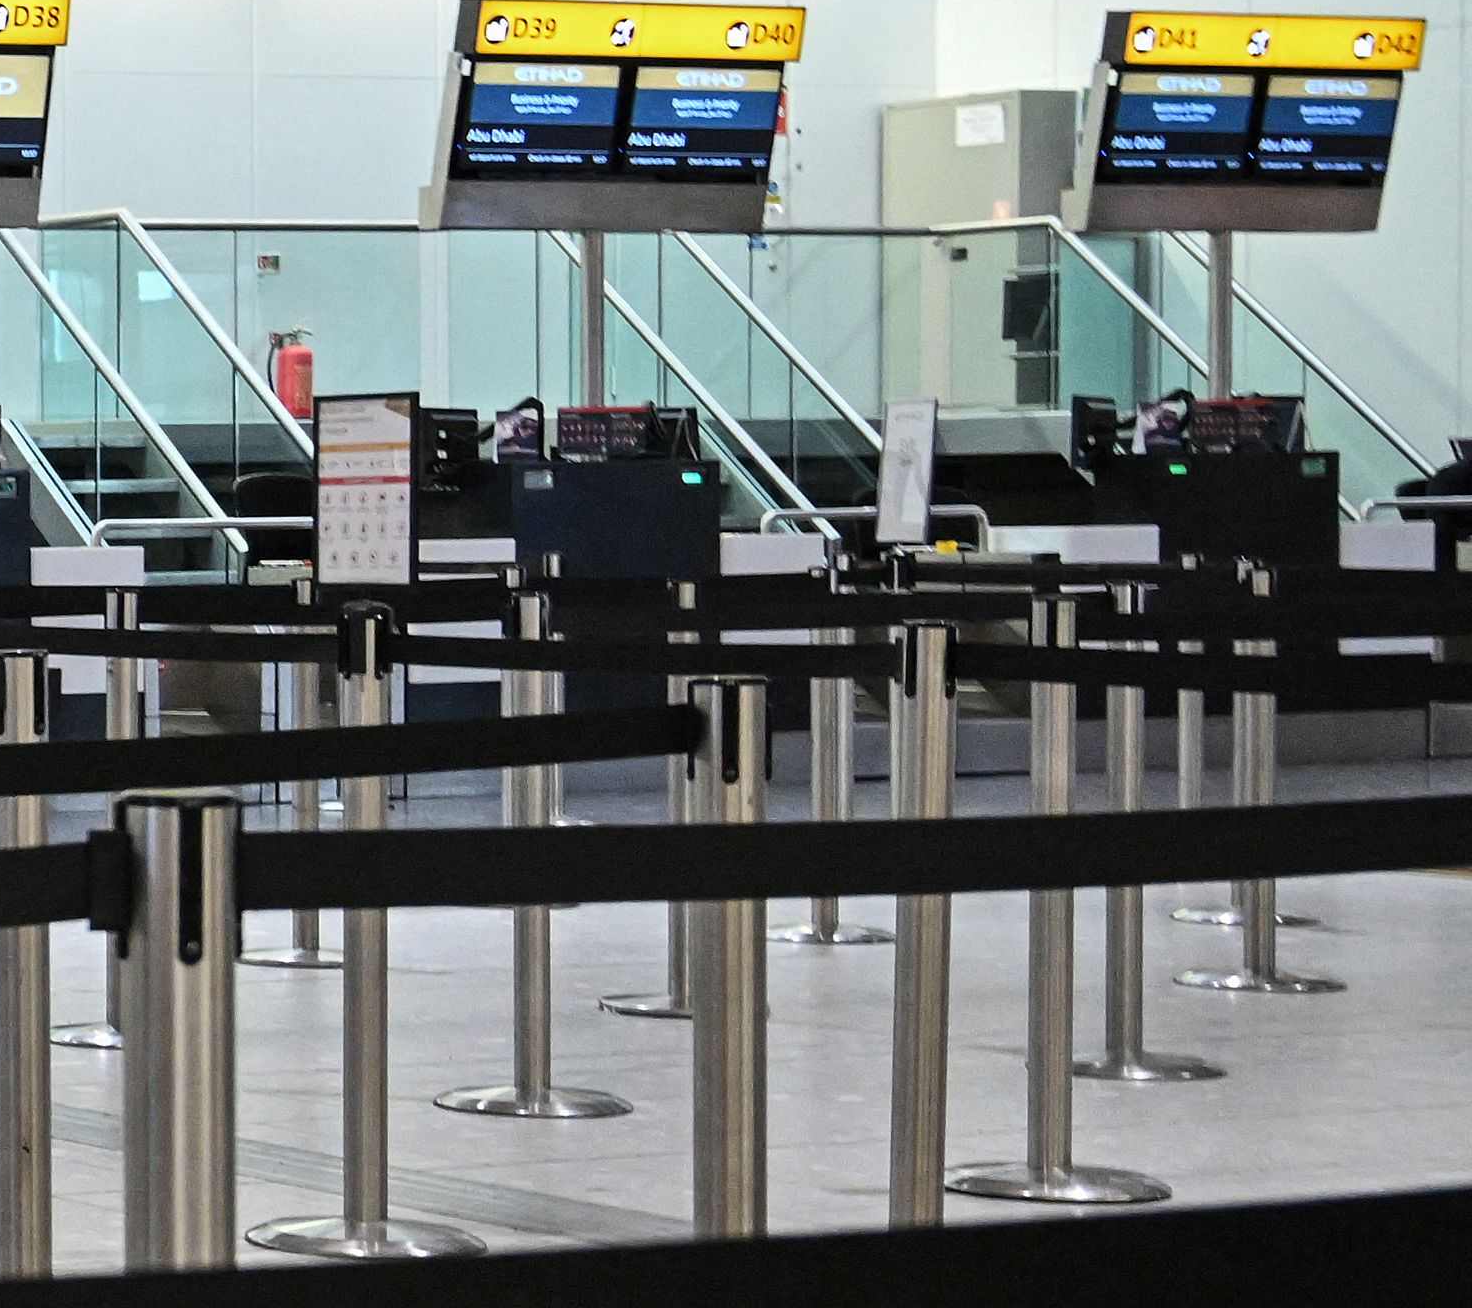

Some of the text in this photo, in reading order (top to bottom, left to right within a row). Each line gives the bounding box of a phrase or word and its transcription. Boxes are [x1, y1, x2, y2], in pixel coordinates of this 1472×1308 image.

[13, 5, 60, 28] D38
[512, 16, 796, 45] D39 D40
[1158, 27, 1417, 55] D41 D42
[514, 66, 584, 83] ETIHAD
[676, 70, 747, 88] ETIHAD
[466, 129, 526, 143] Abu Dhabi
[627, 132, 686, 147] Abu Dhabi
